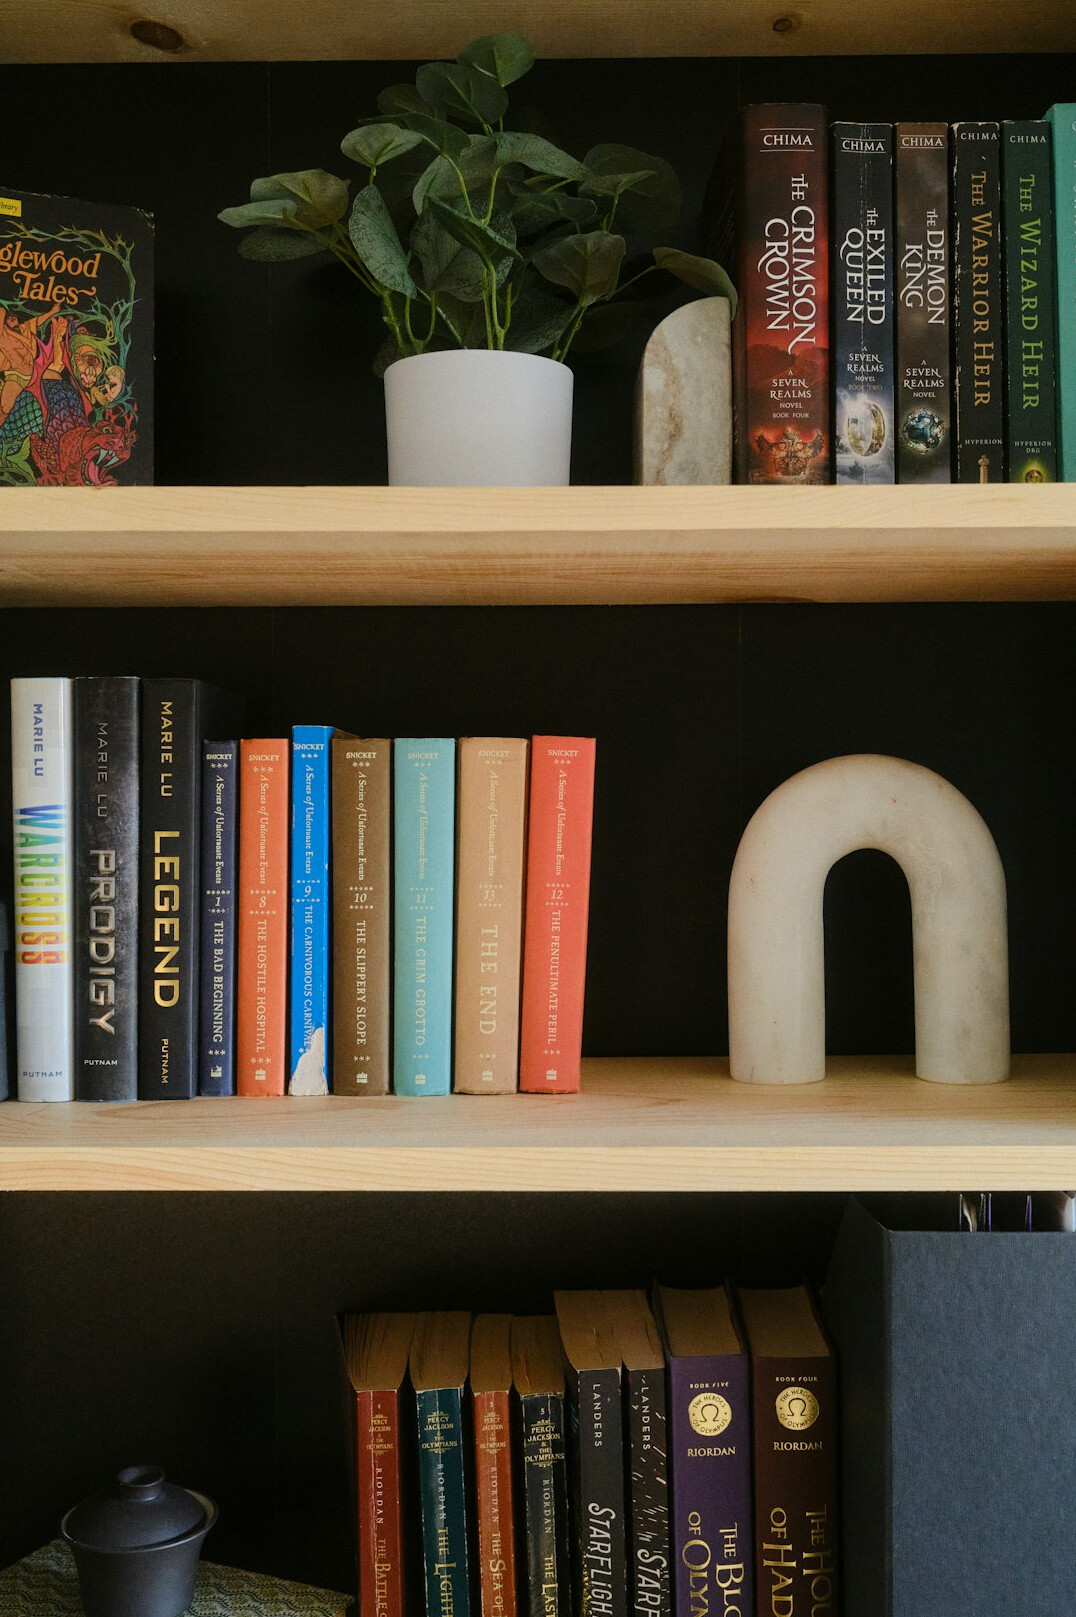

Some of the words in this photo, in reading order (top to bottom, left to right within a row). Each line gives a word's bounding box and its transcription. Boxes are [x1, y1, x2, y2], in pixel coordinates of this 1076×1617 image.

[763, 134, 812, 146] CHIMA
[842, 141, 884, 151] CHIMA
[902, 138, 943, 147] CHIMA
[791, 174, 808, 201] THE
[971, 171, 986, 207] THE
[1019, 175, 1035, 212] THE
[866, 208, 878, 226] THE
[926, 209, 938, 226] THE
[758, 218, 790, 331] CROWN
[787, 205, 816, 356] CRIMSON
[840, 228, 864, 323] QUEEN
[866, 228, 886, 324] EXILED
[900, 244, 926, 308] KING
[926, 229, 945, 325] DEMON
[971, 211, 992, 334] WARRIOR
[1020, 218, 1041, 331] WIZARD
[13, 271, 97, 305] Tales
[847, 364, 884, 373] REALMS
[849, 353, 882, 363] SEVEN
[772, 379, 809, 388] SEVEN
[903, 380, 944, 390] REALMS
[906, 368, 942, 378] SEVEN
[974, 342, 994, 406] HEIR
[1022, 341, 1043, 410] HEIR
[770, 390, 812, 400] REALMS
[33, 704, 43, 752] MARIE
[161, 701, 173, 764] MARIE
[97, 722, 108, 782] MARIE
[34, 759, 44, 777] LU
[559, 769, 567, 778] A
[161, 773, 173, 797] LU
[216, 783, 225, 805] Series
[260, 783, 268, 804] Series
[305, 773, 314, 794] Series
[358, 780, 367, 800] Series
[558, 779, 567, 800] Series
[97, 794, 107, 817] LU
[216, 807, 225, 816] of
[258, 806, 268, 816] of
[303, 796, 314, 806] of
[355, 803, 367, 813] of
[556, 802, 567, 810] of
[215, 817, 225, 859] Unfortunate
[259, 817, 268, 859] Unfortunate
[305, 807, 314, 849] Unfortunate
[358, 814, 367, 855] Unfortunate
[557, 813, 566, 852] Unfortunate
[215, 861, 225, 884] Events
[260, 862, 268, 884] Events
[305, 851, 314, 874] Events
[358, 857, 367, 881] Events
[555, 854, 565, 875] Events
[14, 805, 68, 964] WARCROSS
[304, 885, 312, 898] 9
[484, 890, 495, 902] 13
[551, 890, 563, 900] 12
[215, 896, 221, 907] 1
[259, 896, 266, 908] 8
[354, 893, 367, 903] 10
[154, 831, 180, 1008] LEGEND
[305, 905, 313, 924] THE
[551, 910, 561, 931] THE
[213, 921, 224, 944] THE
[257, 920, 267, 941] THE
[356, 920, 366, 944] THE
[416, 917, 427, 942] THE
[89, 850, 115, 1035] PRODIGY
[480, 925, 498, 973] THE
[213, 948, 224, 971] BAD
[257, 945, 267, 992] HOSTILE
[304, 927, 313, 997] CARNIVOROUS
[415, 949, 426, 983] GRIM
[356, 948, 366, 1002] SLIPPERY
[549, 935, 560, 1010] PENULTIMATE
[213, 976, 224, 1043] BEGINNING
[415, 990, 425, 1045] GROTTO
[479, 986, 497, 1035] END
[256, 996, 267, 1053] HOSPITAL
[356, 1007, 367, 1045] SLOPE
[548, 1015, 557, 1044] PERIL
[161, 1038, 169, 1083] PUTNAM
[693, 1399, 702, 1409] THE
[703, 1396, 727, 1408] HEROES
[780, 1392, 790, 1402] THE
[424, 1423, 454, 1431] JACKSON
[592, 1383, 603, 1447] LANDERS
[641, 1387, 651, 1450] LANDERS
[700, 1419, 728, 1434] OLYMPUS
[527, 1433, 561, 1442] JACKSON
[531, 1426, 556, 1434] PERCY
[422, 1441, 458, 1449] OLYMPIANS
[687, 1447, 736, 1457] RIORDAN
[773, 1441, 822, 1451] RIORDAN
[525, 1453, 565, 1462] OLYMPIANS
[376, 1468, 384, 1524] RIORDAN
[437, 1464, 445, 1519] RIORDAN
[491, 1467, 499, 1523] RIORDAN
[542, 1479, 551, 1534] RIORDAN
[688, 1511, 701, 1535] OF
[770, 1507, 787, 1539] OF
[805, 1504, 827, 1546] THE
[377, 1538, 387, 1559] THE
[438, 1527, 450, 1556] THE
[491, 1532, 501, 1555] THE
[719, 1522, 738, 1559] THE
[489, 1559, 507, 1591] SEA
[545, 1555, 554, 1578] THE
[376, 1563, 391, 1609] BATTLE
[762, 1542, 797, 1617] HAD
